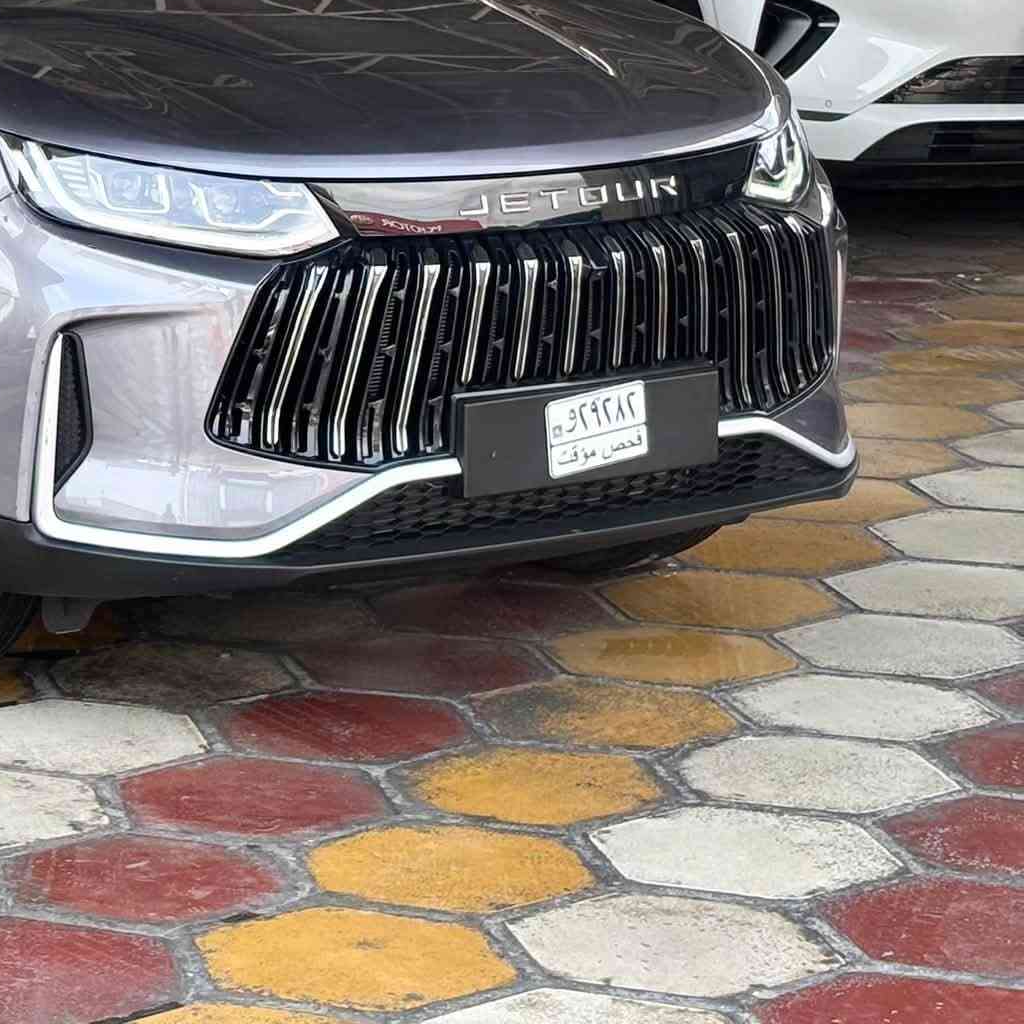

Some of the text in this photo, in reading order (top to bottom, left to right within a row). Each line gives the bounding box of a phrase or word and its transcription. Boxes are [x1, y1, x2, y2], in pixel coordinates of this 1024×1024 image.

[459, 174, 678, 216] JETOUR
[558, 428, 643, 466] فحص مؤقت
